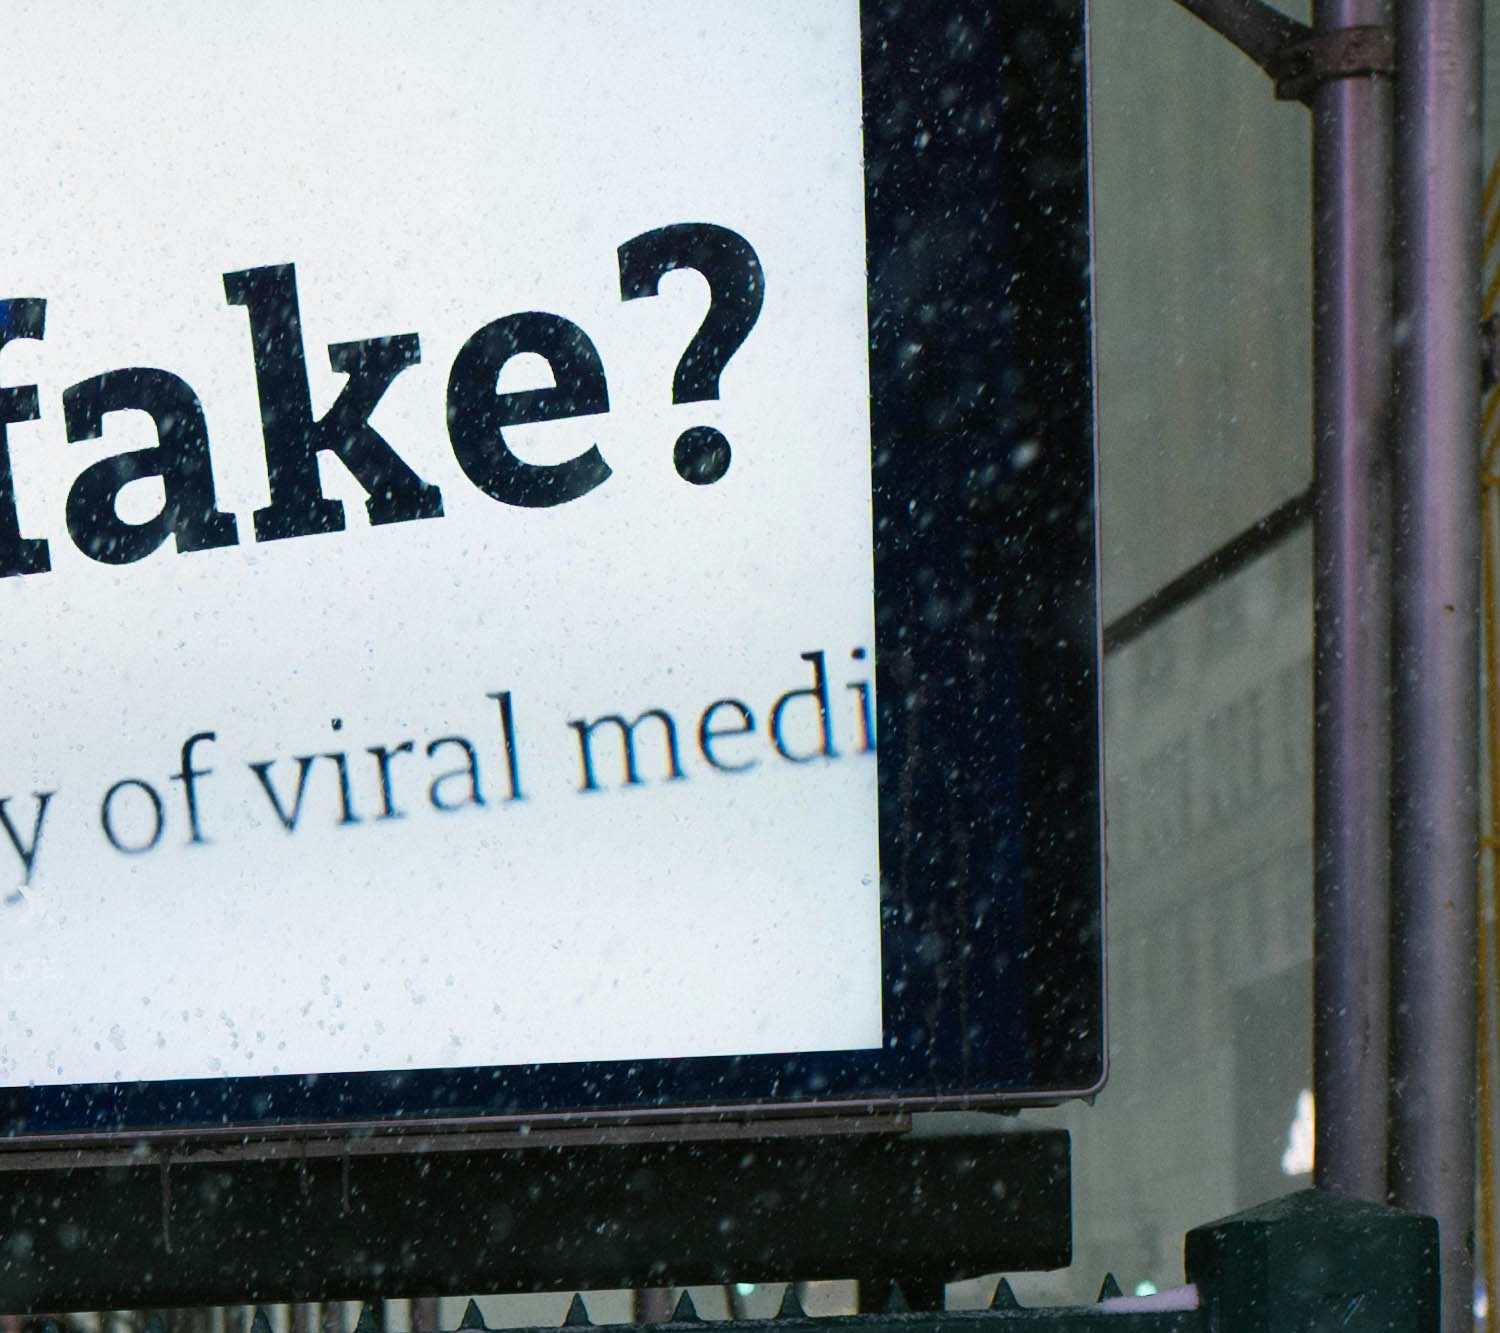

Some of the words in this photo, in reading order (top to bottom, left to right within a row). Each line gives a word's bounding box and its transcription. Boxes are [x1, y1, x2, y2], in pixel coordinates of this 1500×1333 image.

[100, 730, 219, 854] of
[246, 690, 526, 834] viral
[567, 646, 878, 794] medi
